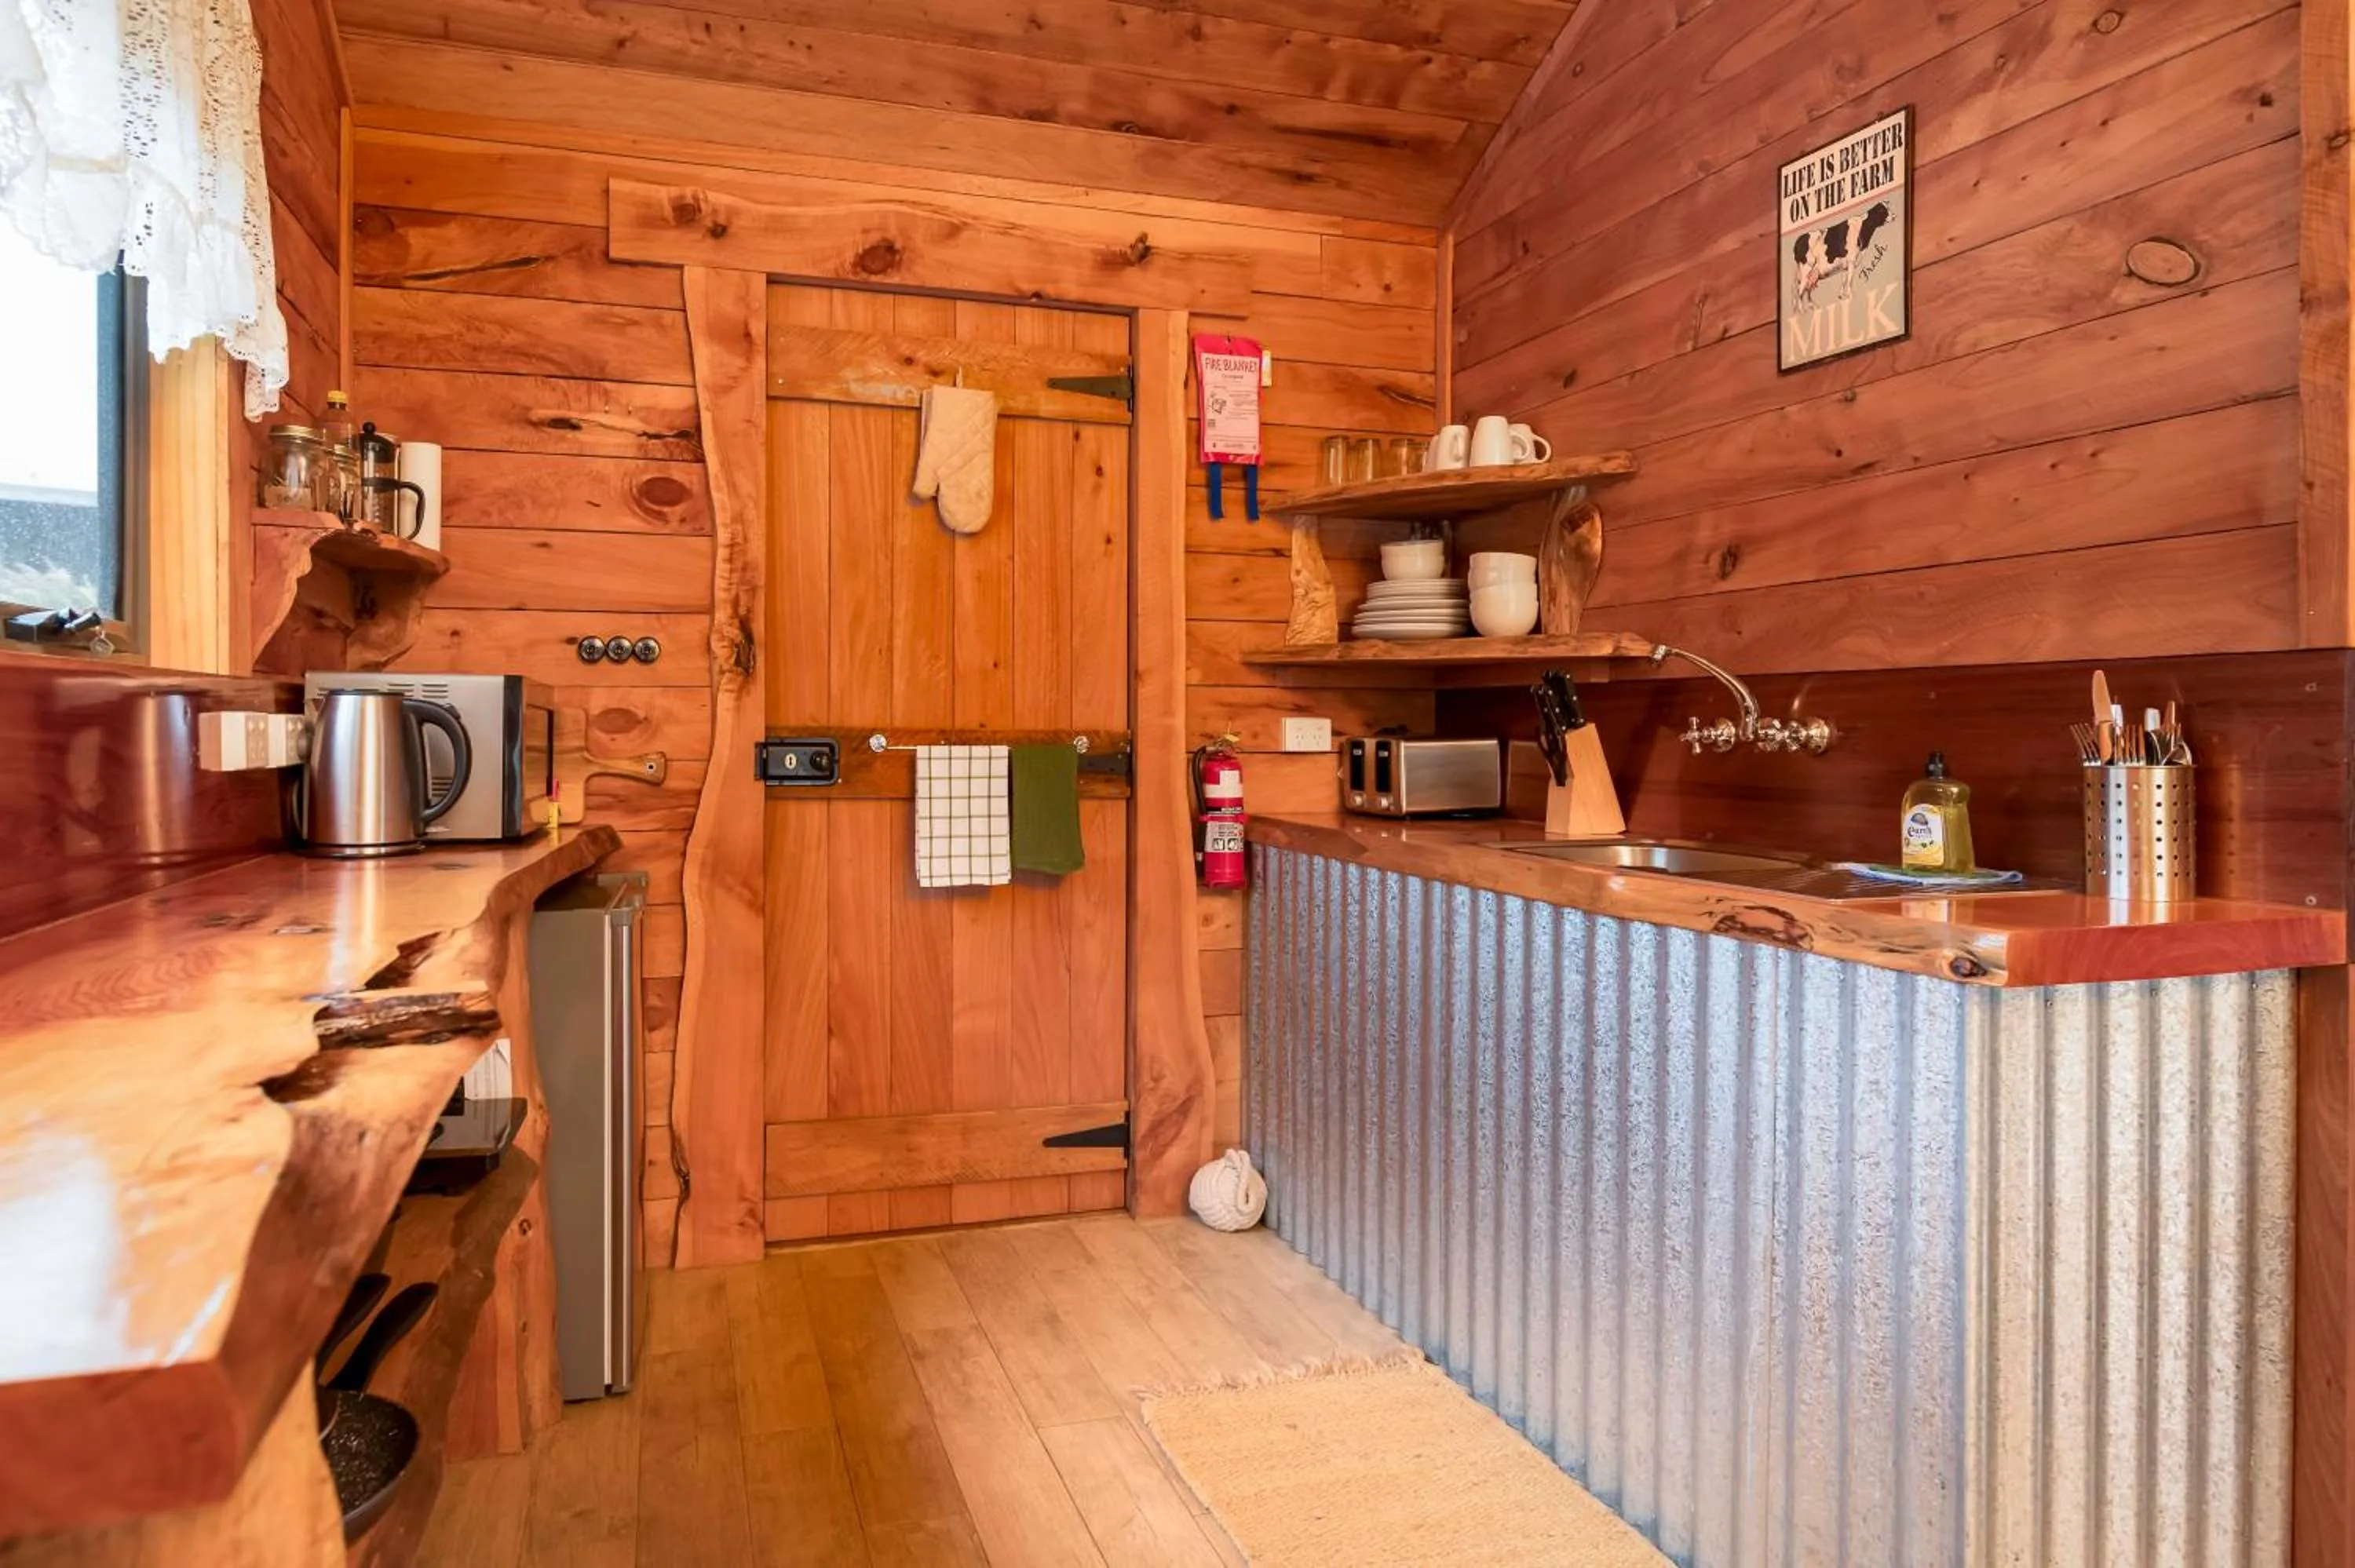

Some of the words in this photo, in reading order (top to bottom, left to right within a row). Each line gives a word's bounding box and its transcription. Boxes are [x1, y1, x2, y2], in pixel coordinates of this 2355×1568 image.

[1784, 162, 1816, 199] LIFE
[1820, 154, 1835, 183] IS
[1839, 122, 1903, 173] BETTER
[1790, 192, 1810, 223] ON
[1815, 177, 1846, 213] THE
[1850, 155, 1894, 199] FARM
[1858, 243, 1888, 282] Fresh
[1787, 283, 1900, 361] MILK
